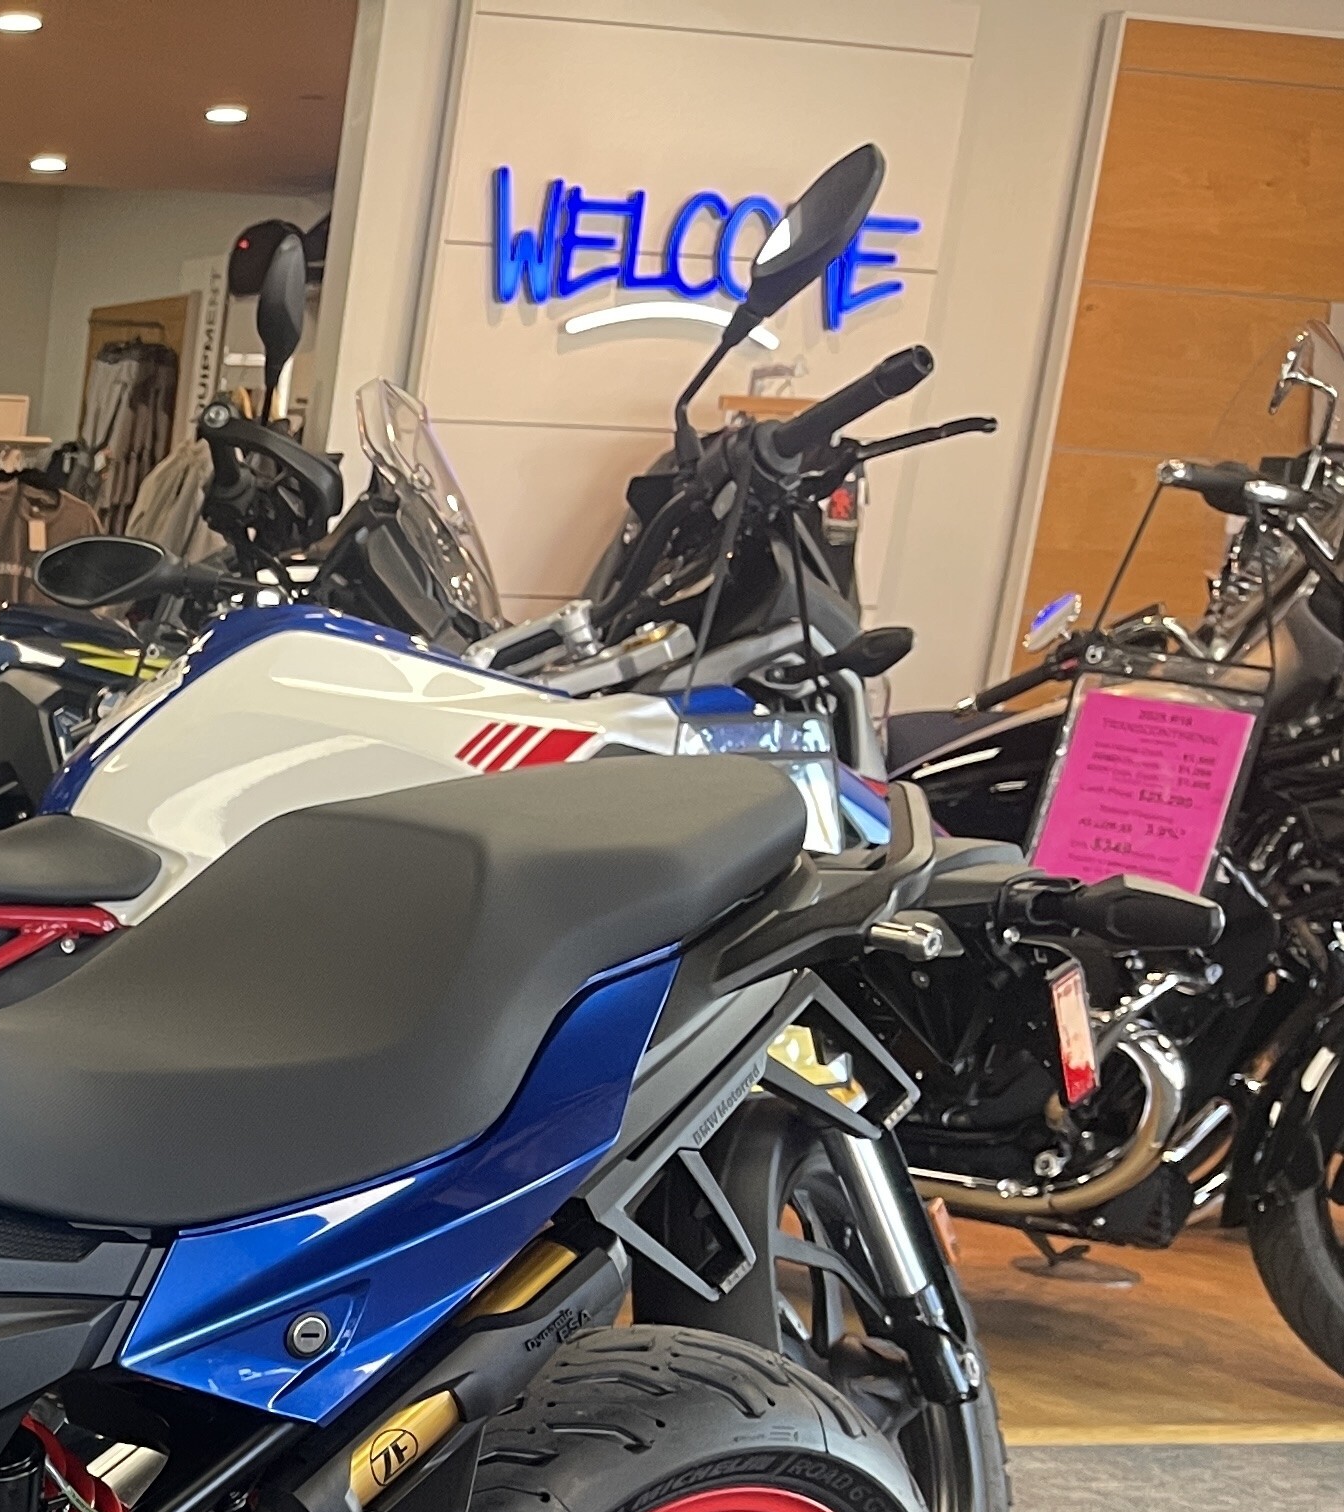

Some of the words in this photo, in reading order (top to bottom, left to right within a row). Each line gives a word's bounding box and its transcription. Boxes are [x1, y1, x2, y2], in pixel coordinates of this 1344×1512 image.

[494, 166, 920, 331] WELCOE
[524, 1308, 574, 1352] Dynamic
[632, 1454, 777, 1509] MICHELIN
[790, 1457, 852, 1493] ROAD
